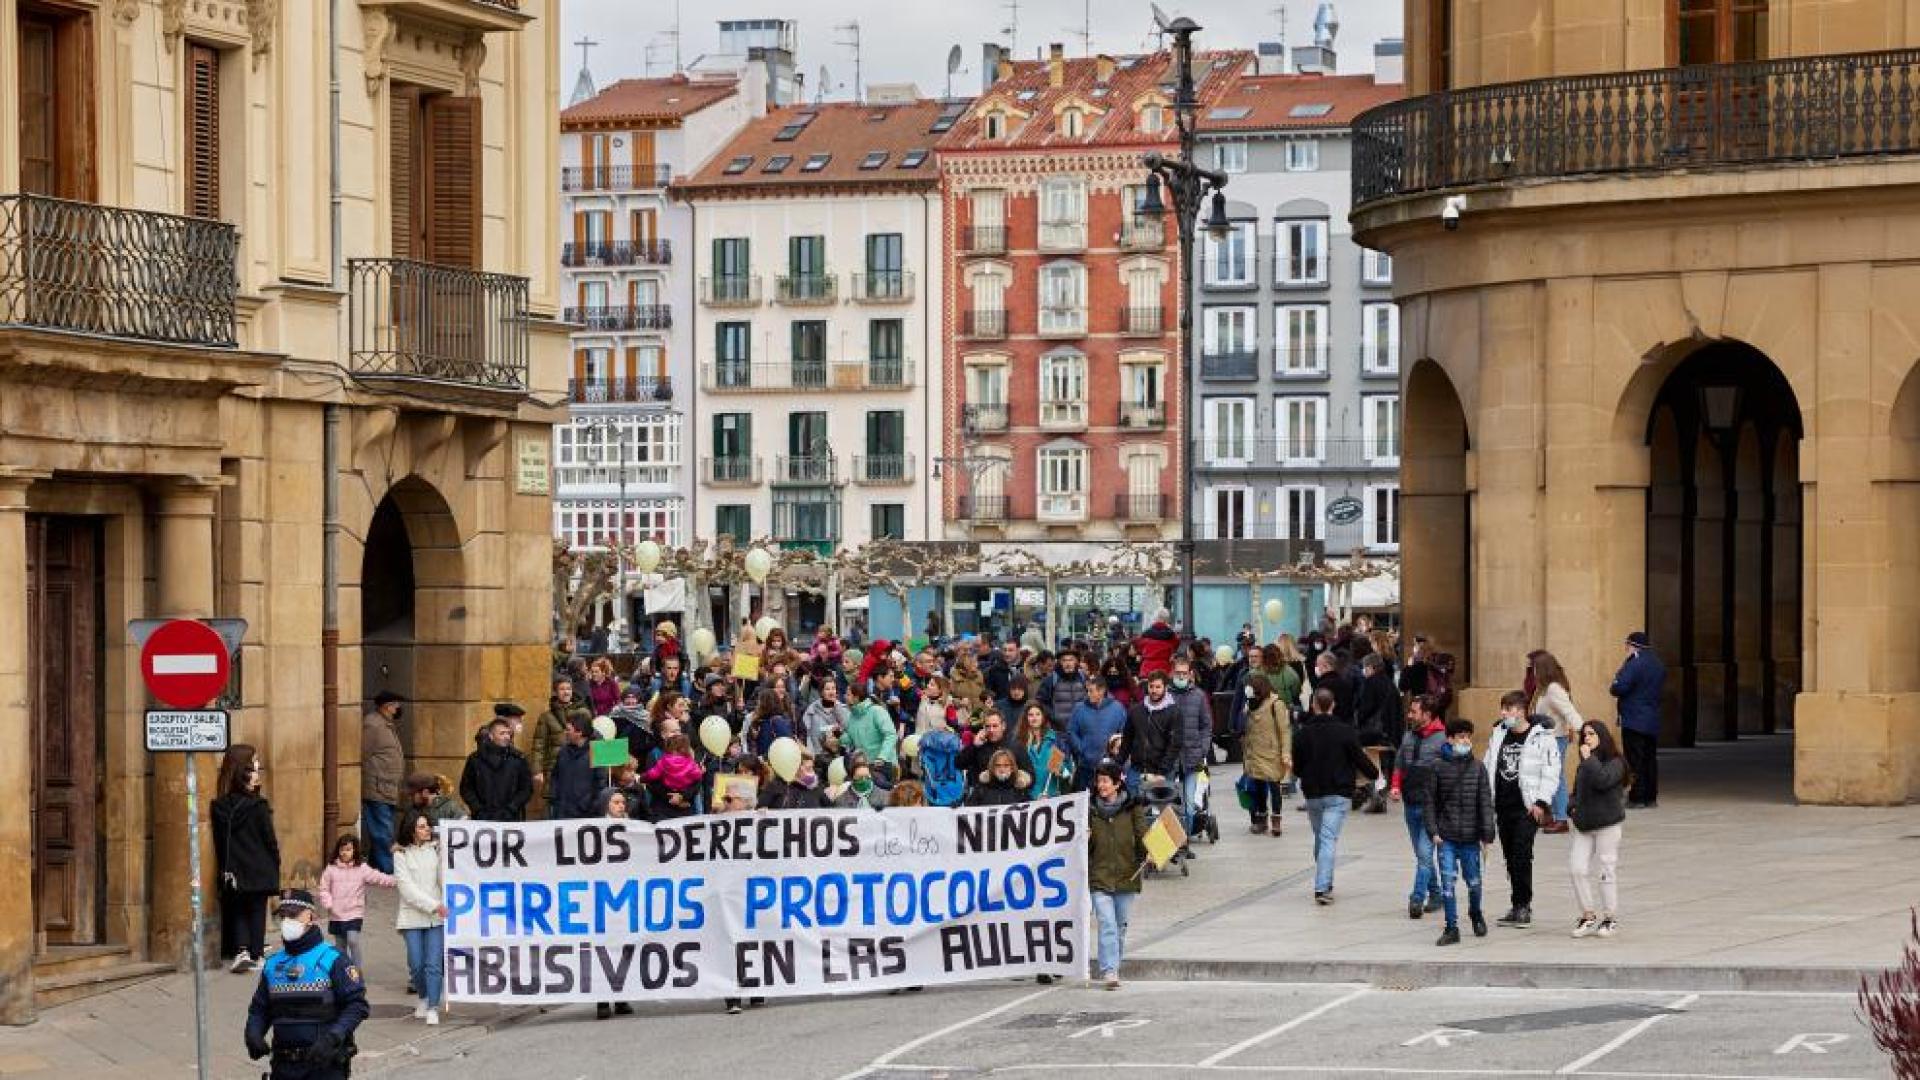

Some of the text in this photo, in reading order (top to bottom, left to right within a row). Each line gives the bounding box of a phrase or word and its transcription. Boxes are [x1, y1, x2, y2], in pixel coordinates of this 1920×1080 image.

[448, 827, 528, 869] POR
[554, 823, 631, 866] LOS
[654, 816, 860, 864] DERECHOS
[874, 821, 903, 857] de
[909, 818, 940, 855] los
[445, 857, 1068, 936] PAREMOS PROTOCOLOS
[736, 940, 796, 988] EN
[821, 936, 907, 983] LAS
[940, 919, 1075, 973] AULAS
[1773, 1033, 1850, 1054] R
